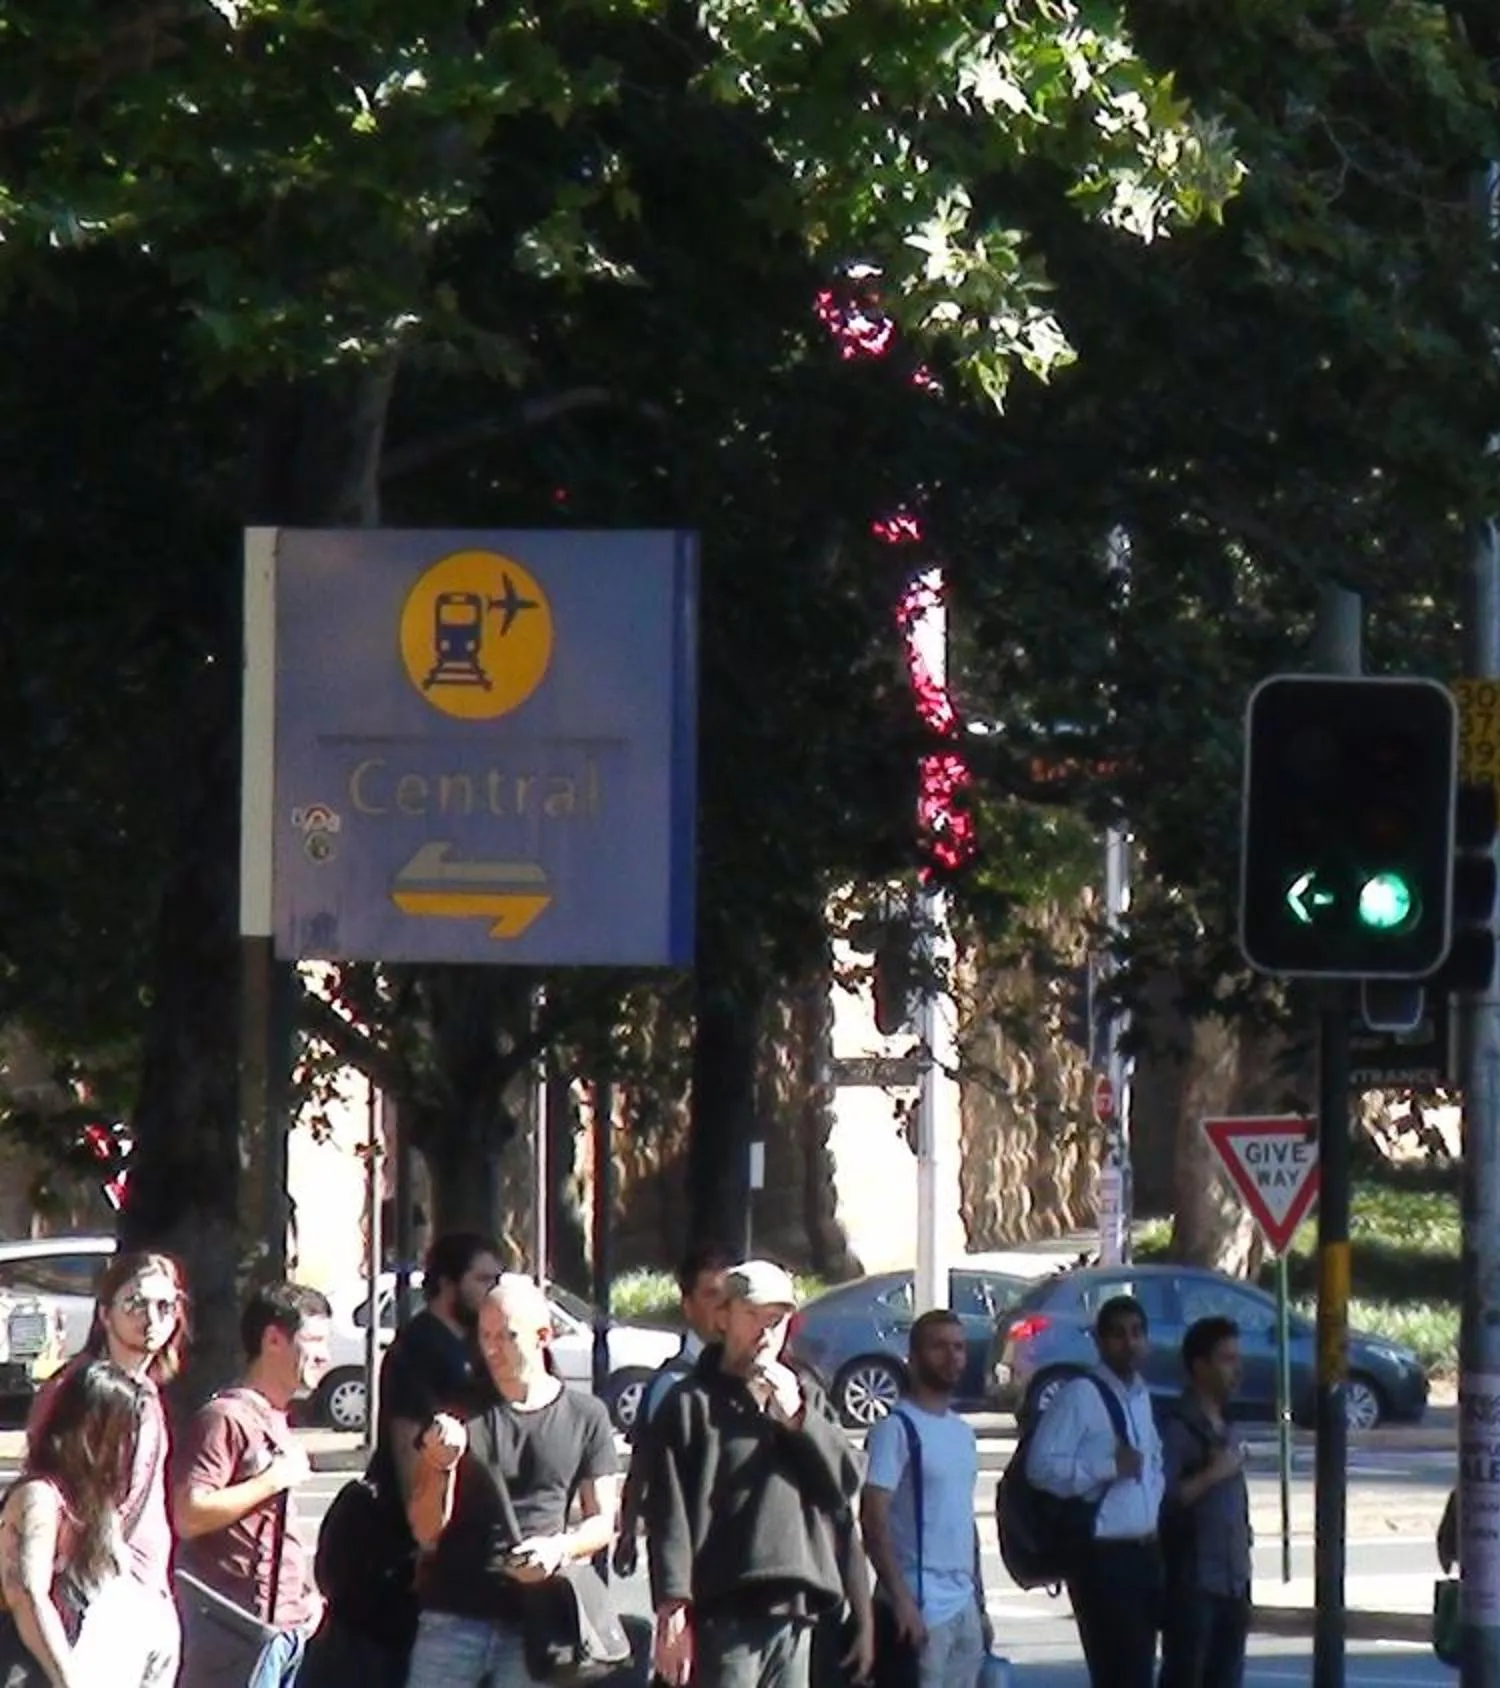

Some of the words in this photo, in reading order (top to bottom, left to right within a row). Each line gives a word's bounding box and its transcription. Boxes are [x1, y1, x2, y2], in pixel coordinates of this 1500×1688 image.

[350, 758, 599, 816] Central
[1245, 1142, 1306, 1164] GIVE
[1258, 1168, 1299, 1187] WAY
